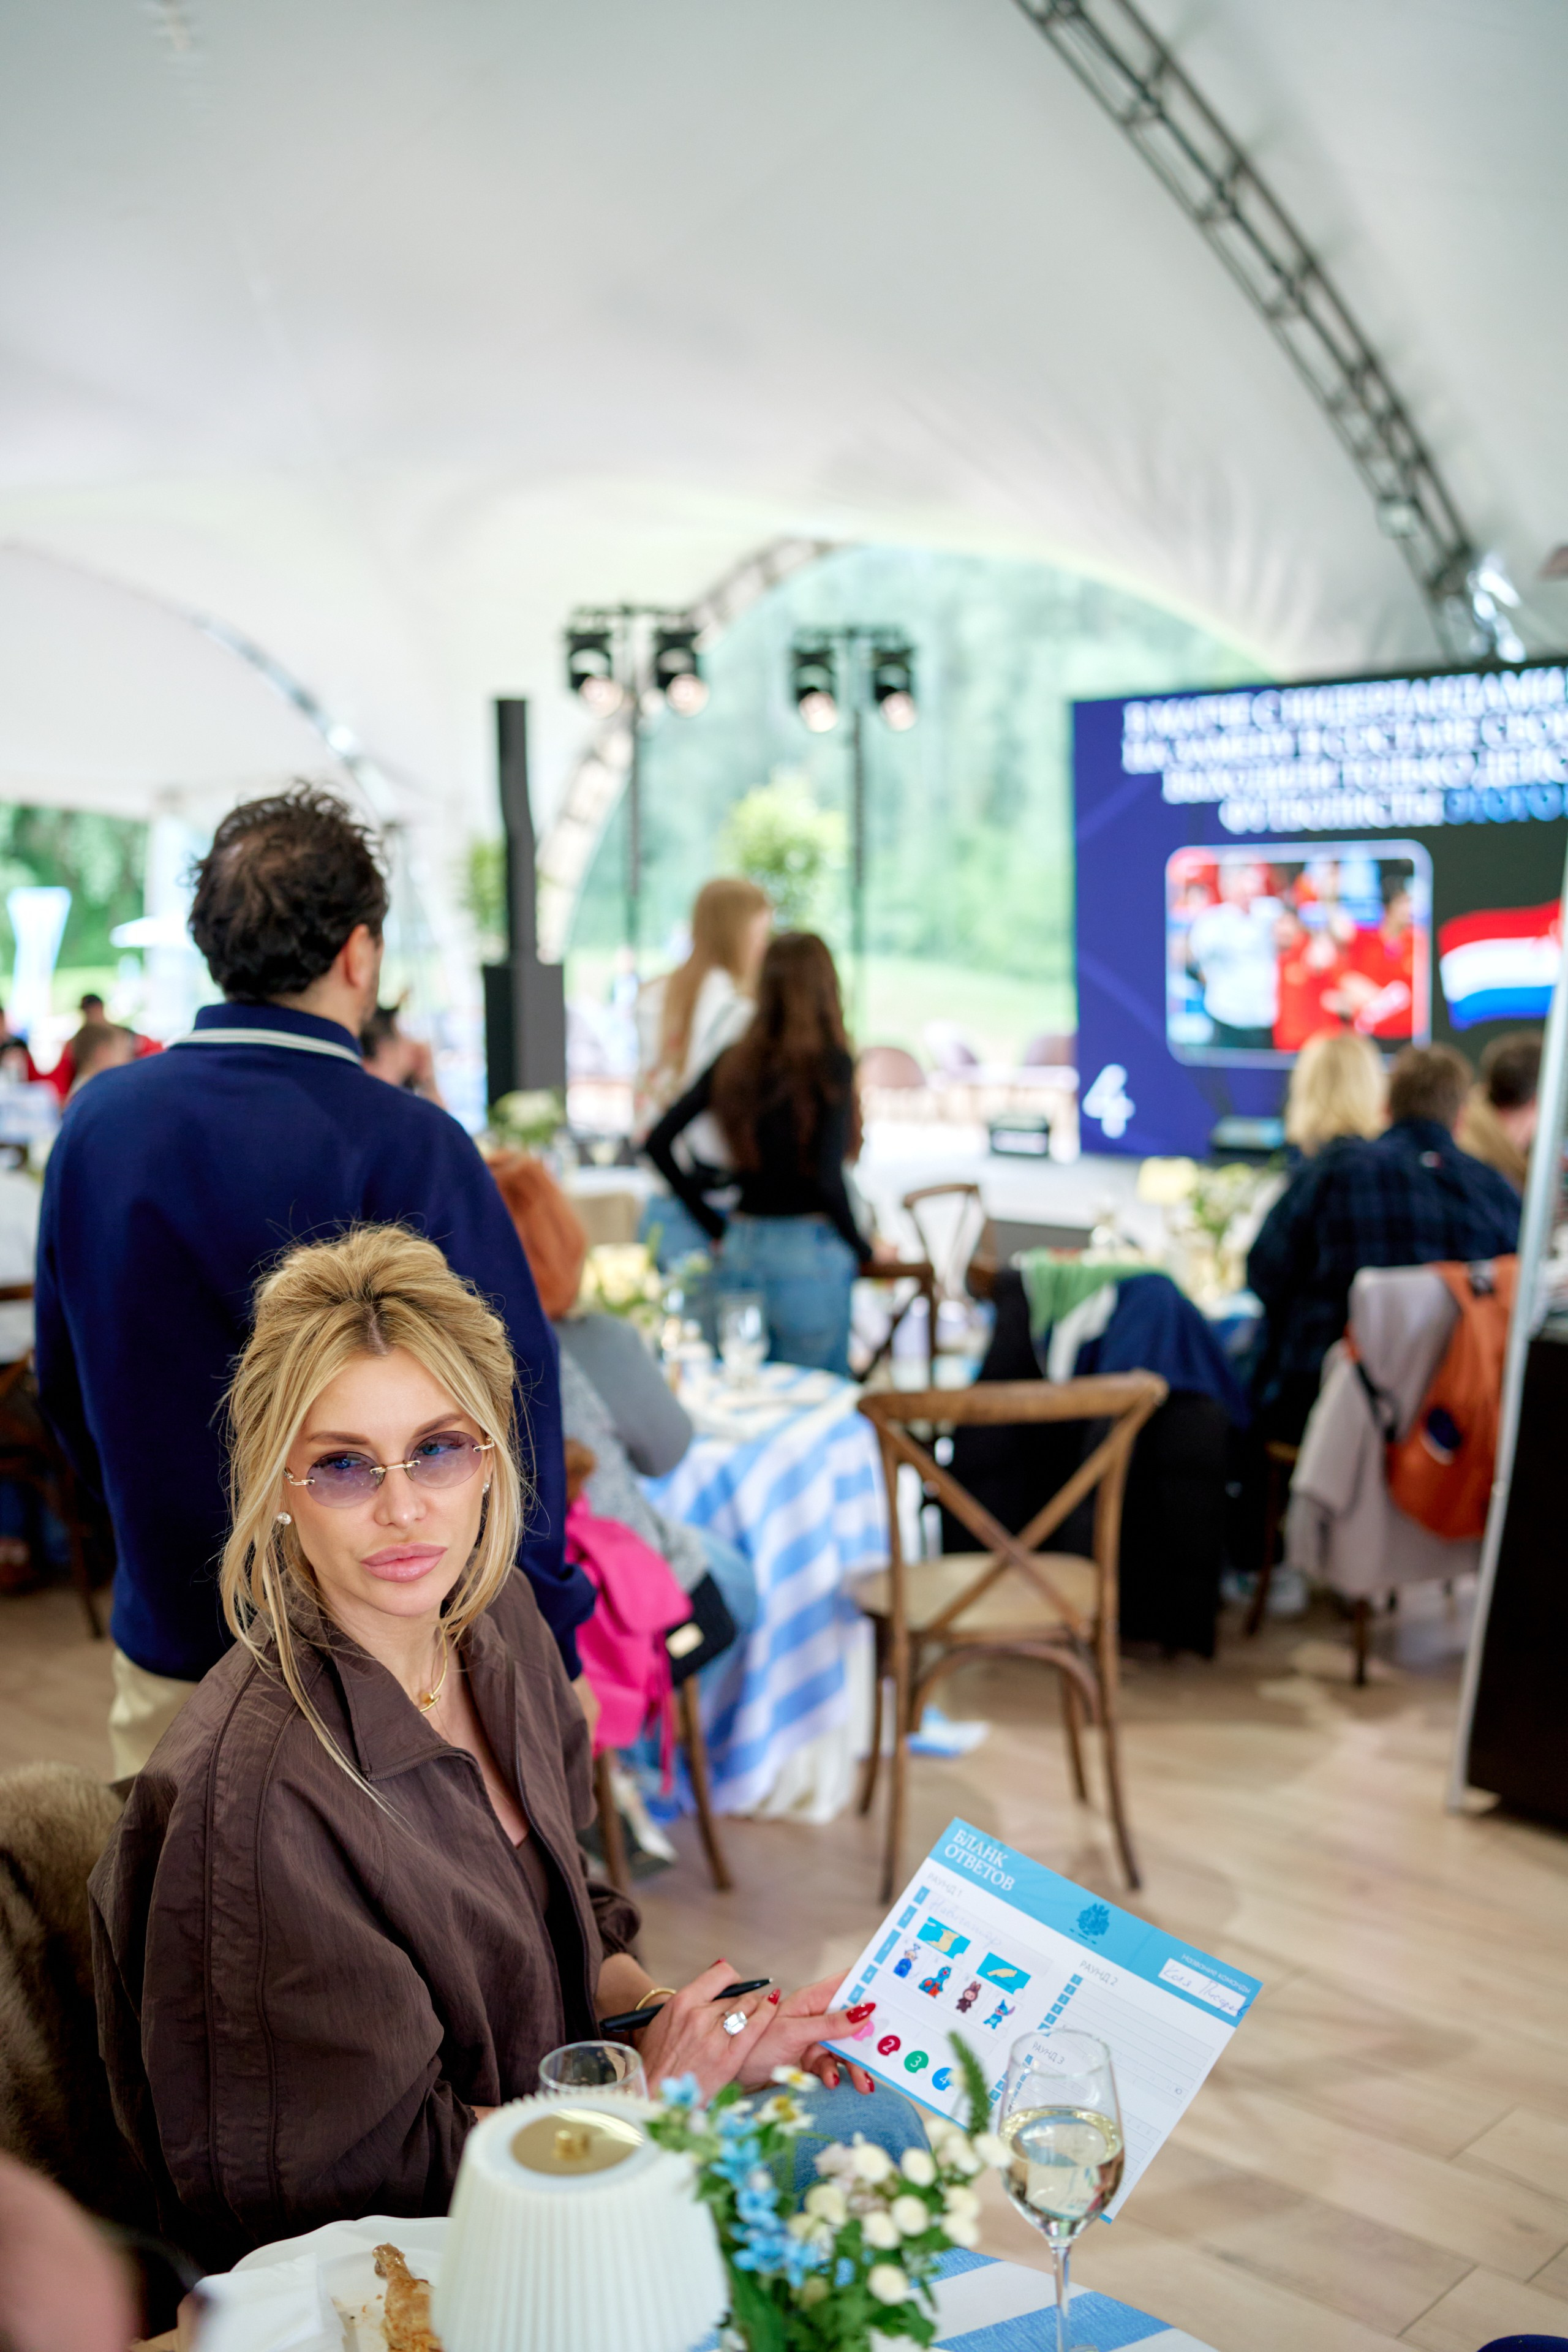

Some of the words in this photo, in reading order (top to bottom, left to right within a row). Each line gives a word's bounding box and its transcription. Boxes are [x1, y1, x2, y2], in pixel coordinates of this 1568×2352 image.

[1082, 1063, 1136, 1139] 4
[952, 1829, 1008, 1868] БЛАНК
[944, 1843, 1016, 1891] ОТВЕТОВ
[928, 1873, 956, 1896] РАУНД
[1079, 1960, 1110, 1983] РАУНД
[1110, 1977, 1118, 1986] 2
[1181, 1953, 1217, 1978] Название
[1218, 1973, 1251, 1994] команды
[882, 2038, 895, 2052] 2
[1032, 2041, 1058, 2062] РАУНД
[1057, 2056, 1065, 2064] 3
[910, 2055, 922, 2067] 3
[939, 2071, 950, 2085] 4
